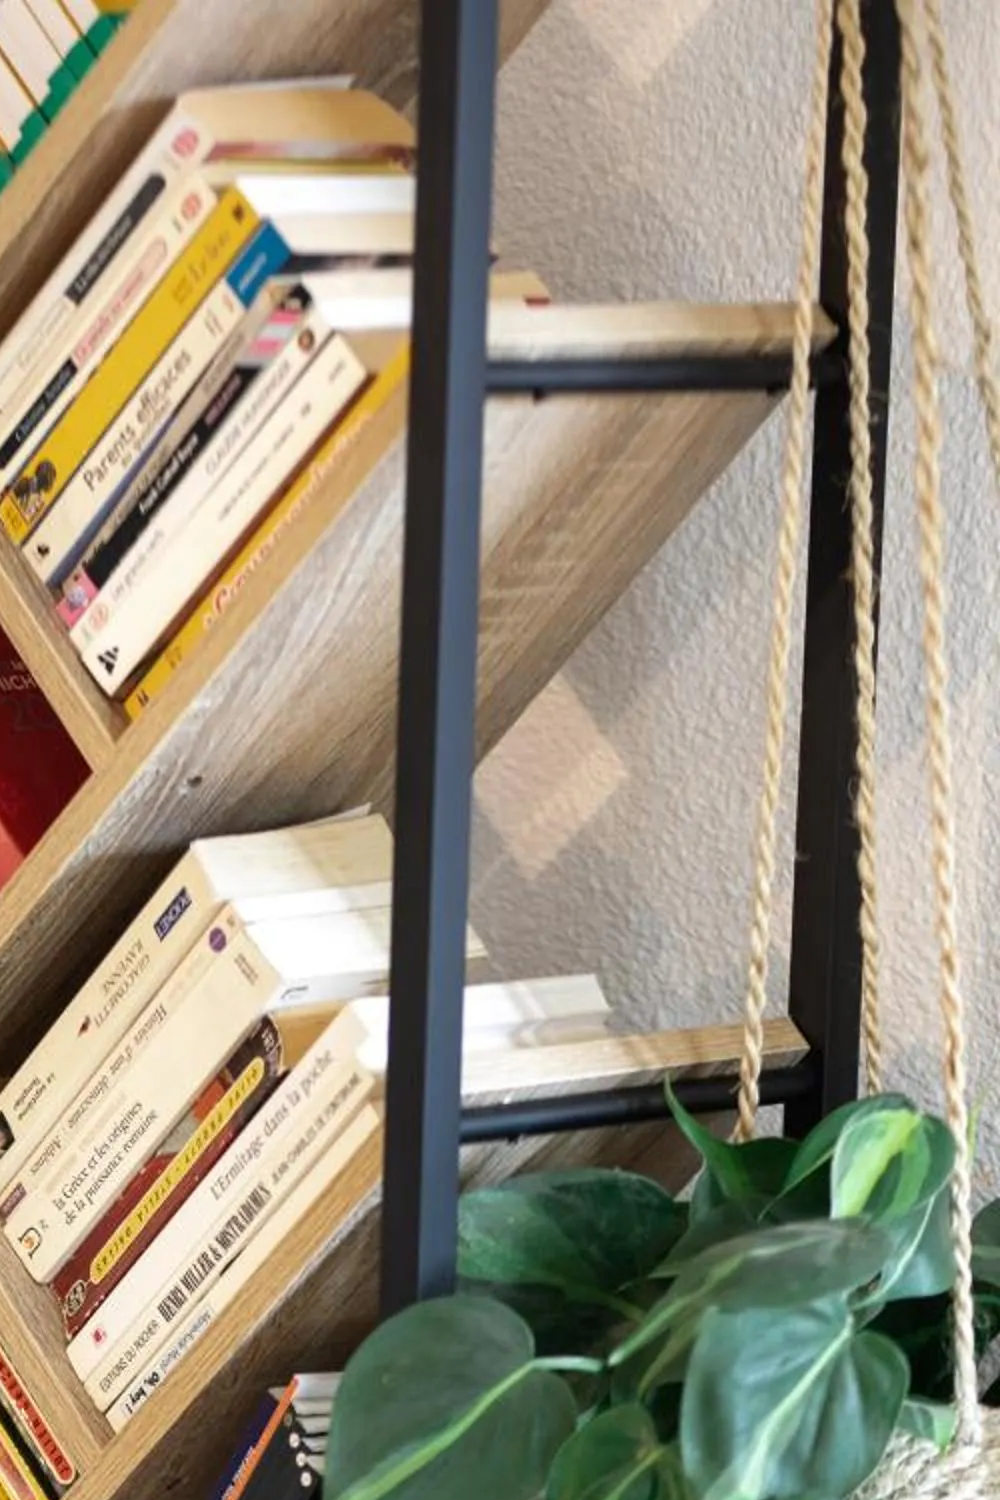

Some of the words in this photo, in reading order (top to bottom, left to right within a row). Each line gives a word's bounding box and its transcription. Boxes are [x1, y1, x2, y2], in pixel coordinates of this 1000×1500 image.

[78, 420, 141, 494] Parents
[128, 345, 195, 425] efficaces
[100, 1096, 147, 1147] origines
[258, 1101, 293, 1139] dans
